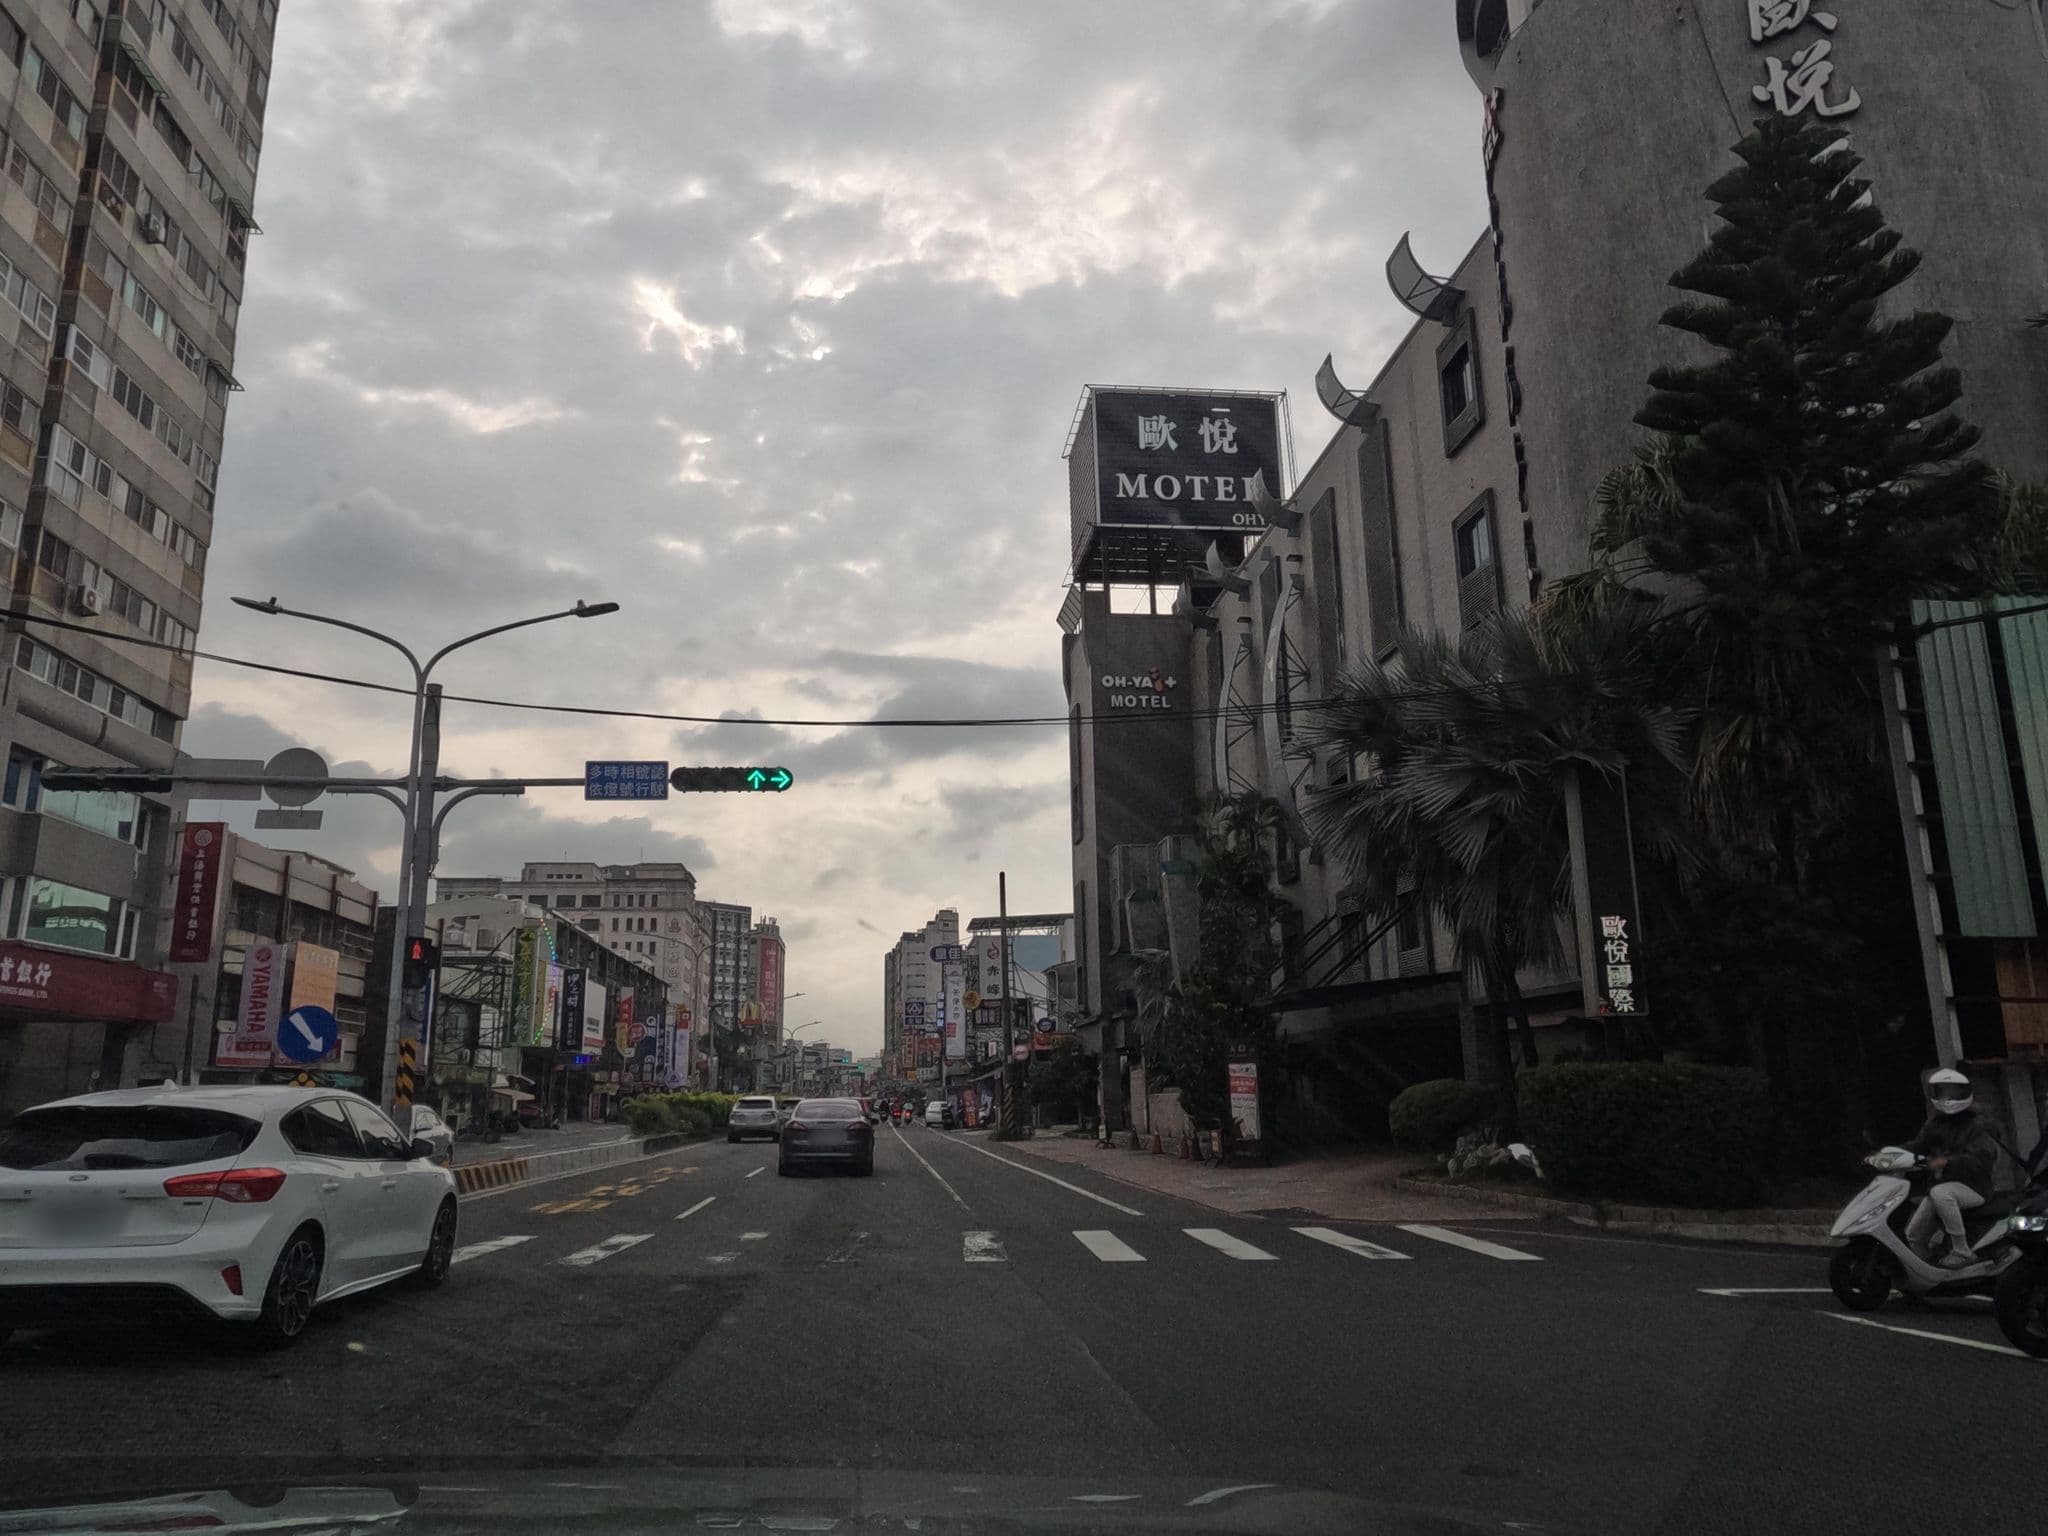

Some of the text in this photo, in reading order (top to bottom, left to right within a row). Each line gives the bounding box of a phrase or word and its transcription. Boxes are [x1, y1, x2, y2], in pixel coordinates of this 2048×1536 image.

[1137, 413, 1239, 455] 歐悅
[1110, 694, 1172, 709] MOTEL
[588, 764, 666, 780] 多時相號誌
[588, 782, 666, 798] 依燈號行駛
[1600, 914, 1635, 1013] 歐悅國際
[246, 964, 273, 1033] YAMAHA
